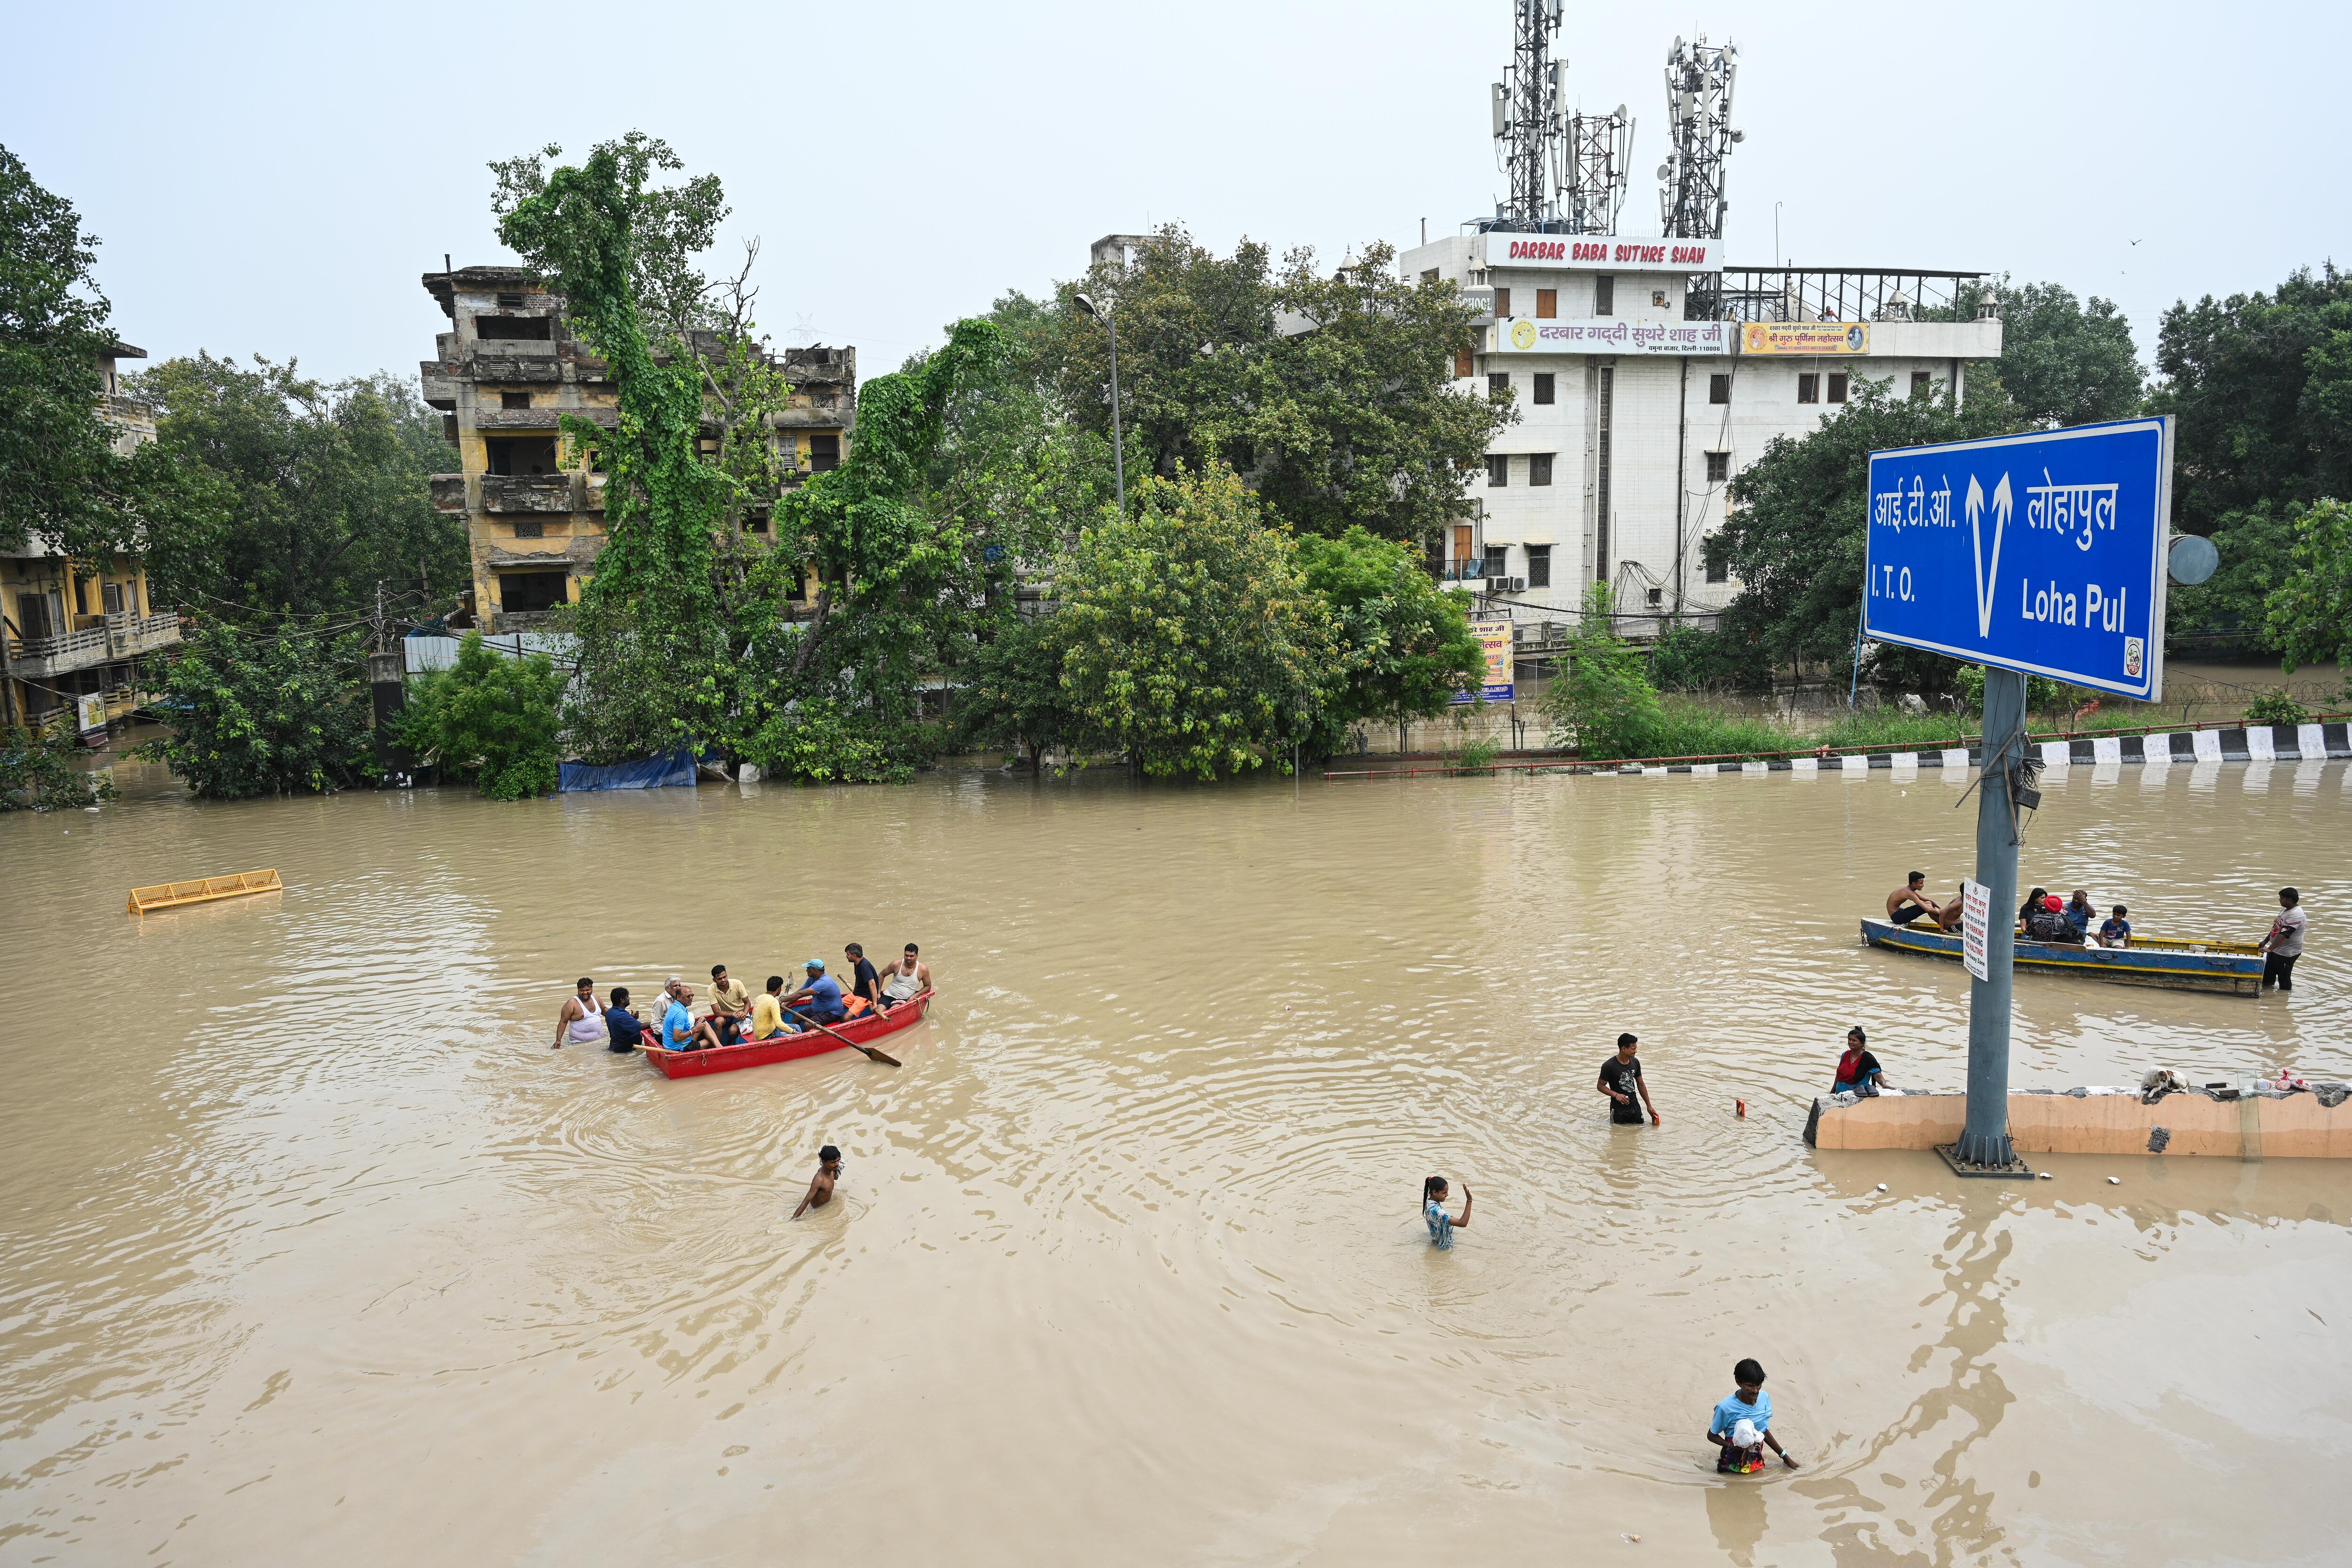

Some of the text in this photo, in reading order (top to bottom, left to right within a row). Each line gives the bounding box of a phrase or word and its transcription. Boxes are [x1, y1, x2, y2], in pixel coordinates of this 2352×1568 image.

[1510, 241, 1706, 263] DARBAR BABA SUTHRE SHAH
[1539, 326, 1584, 339] दरबार
[1632, 323, 1666, 347] सुथरे
[1669, 329, 1698, 342] शाह
[1701, 324, 1722, 341] जी
[1769, 333, 1844, 345] श्री गुरु पूर्णिमा महोत्सव
[1875, 467, 2119, 551] आई.टी.ओ. लोहापुल
[2022, 578, 2126, 633] Loha Pul
[1982, 909, 1985, 918] है
[1965, 921, 1984, 938] NO PARKING
[1966, 931, 1983, 947] NO WAITING
[1966, 940, 1983, 957] NO HALTING
[2152, 1132, 2170, 1140] TUITION
